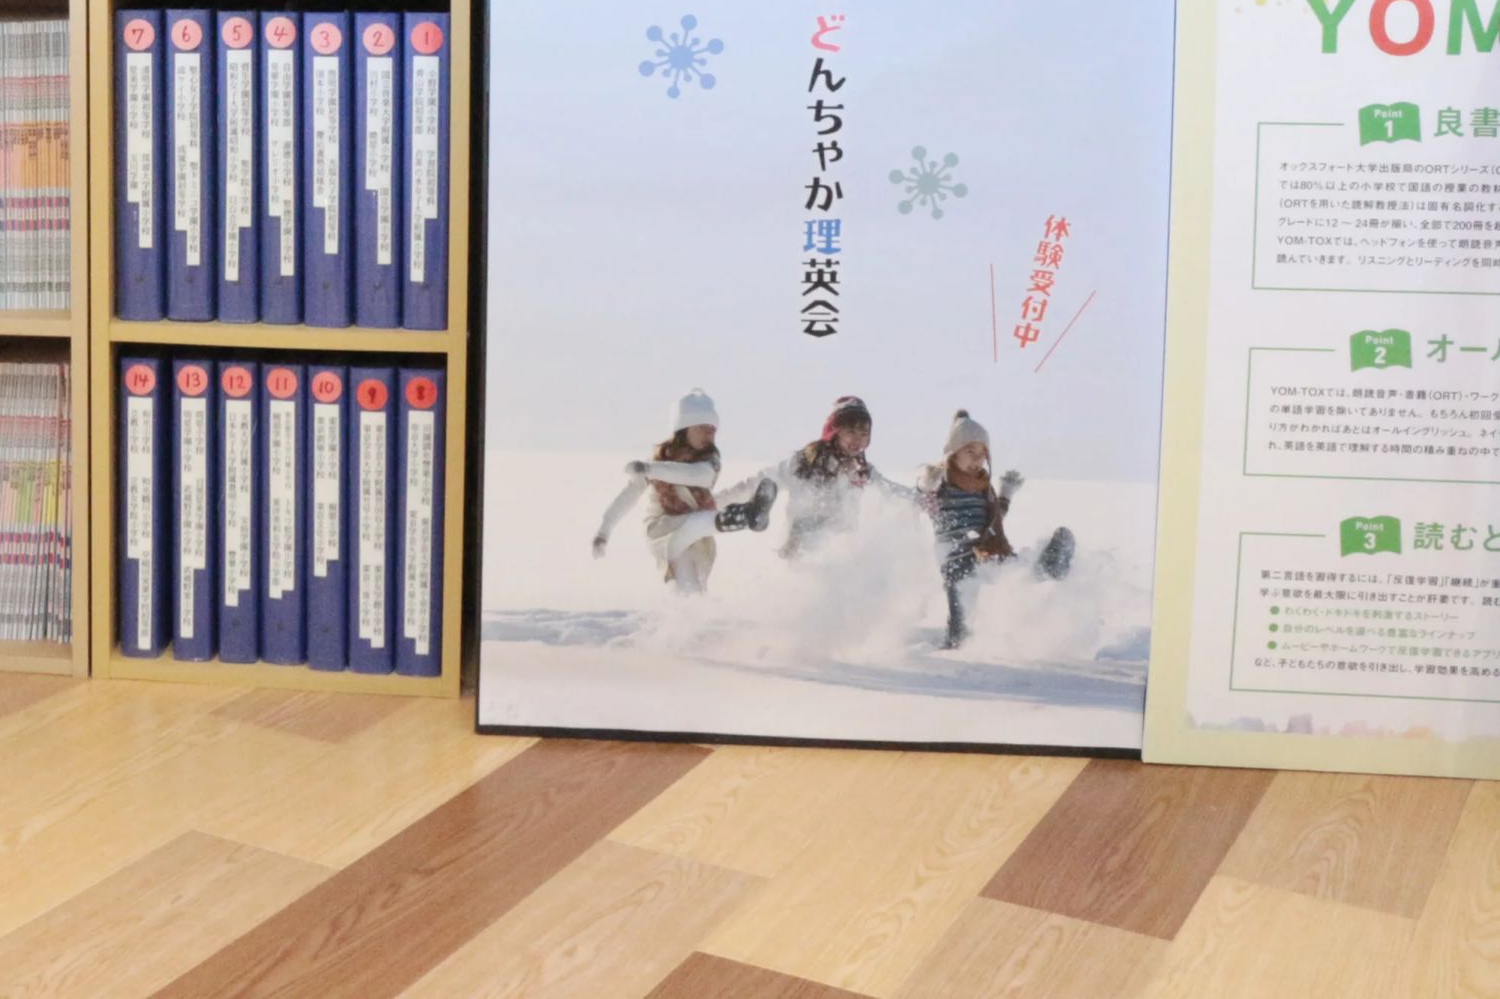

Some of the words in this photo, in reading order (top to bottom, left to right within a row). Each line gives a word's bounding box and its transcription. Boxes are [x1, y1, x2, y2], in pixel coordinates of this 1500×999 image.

[132, 29, 144, 44] 7
[182, 26, 191, 42] 6
[232, 25, 242, 40] 5
[274, 25, 287, 40] 4
[320, 31, 330, 46] 3
[373, 31, 384, 46] 2
[424, 30, 430, 46] 1
[1374, 109, 1402, 119] Point
[1384, 120, 1393, 138] 1
[1434, 106, 1500, 139] 良書
[1013, 212, 1071, 349] 体験受付中
[1364, 335, 1393, 345] Point
[1374, 347, 1387, 365] 2
[133, 372, 148, 388] 14
[186, 372, 201, 388] 13
[230, 374, 245, 389] 12
[276, 376, 288, 391] 11
[319, 380, 334, 394] 10
[368, 387, 377, 404] 9
[1355, 521, 1384, 531] Point
[1364, 533, 1376, 550] 3
